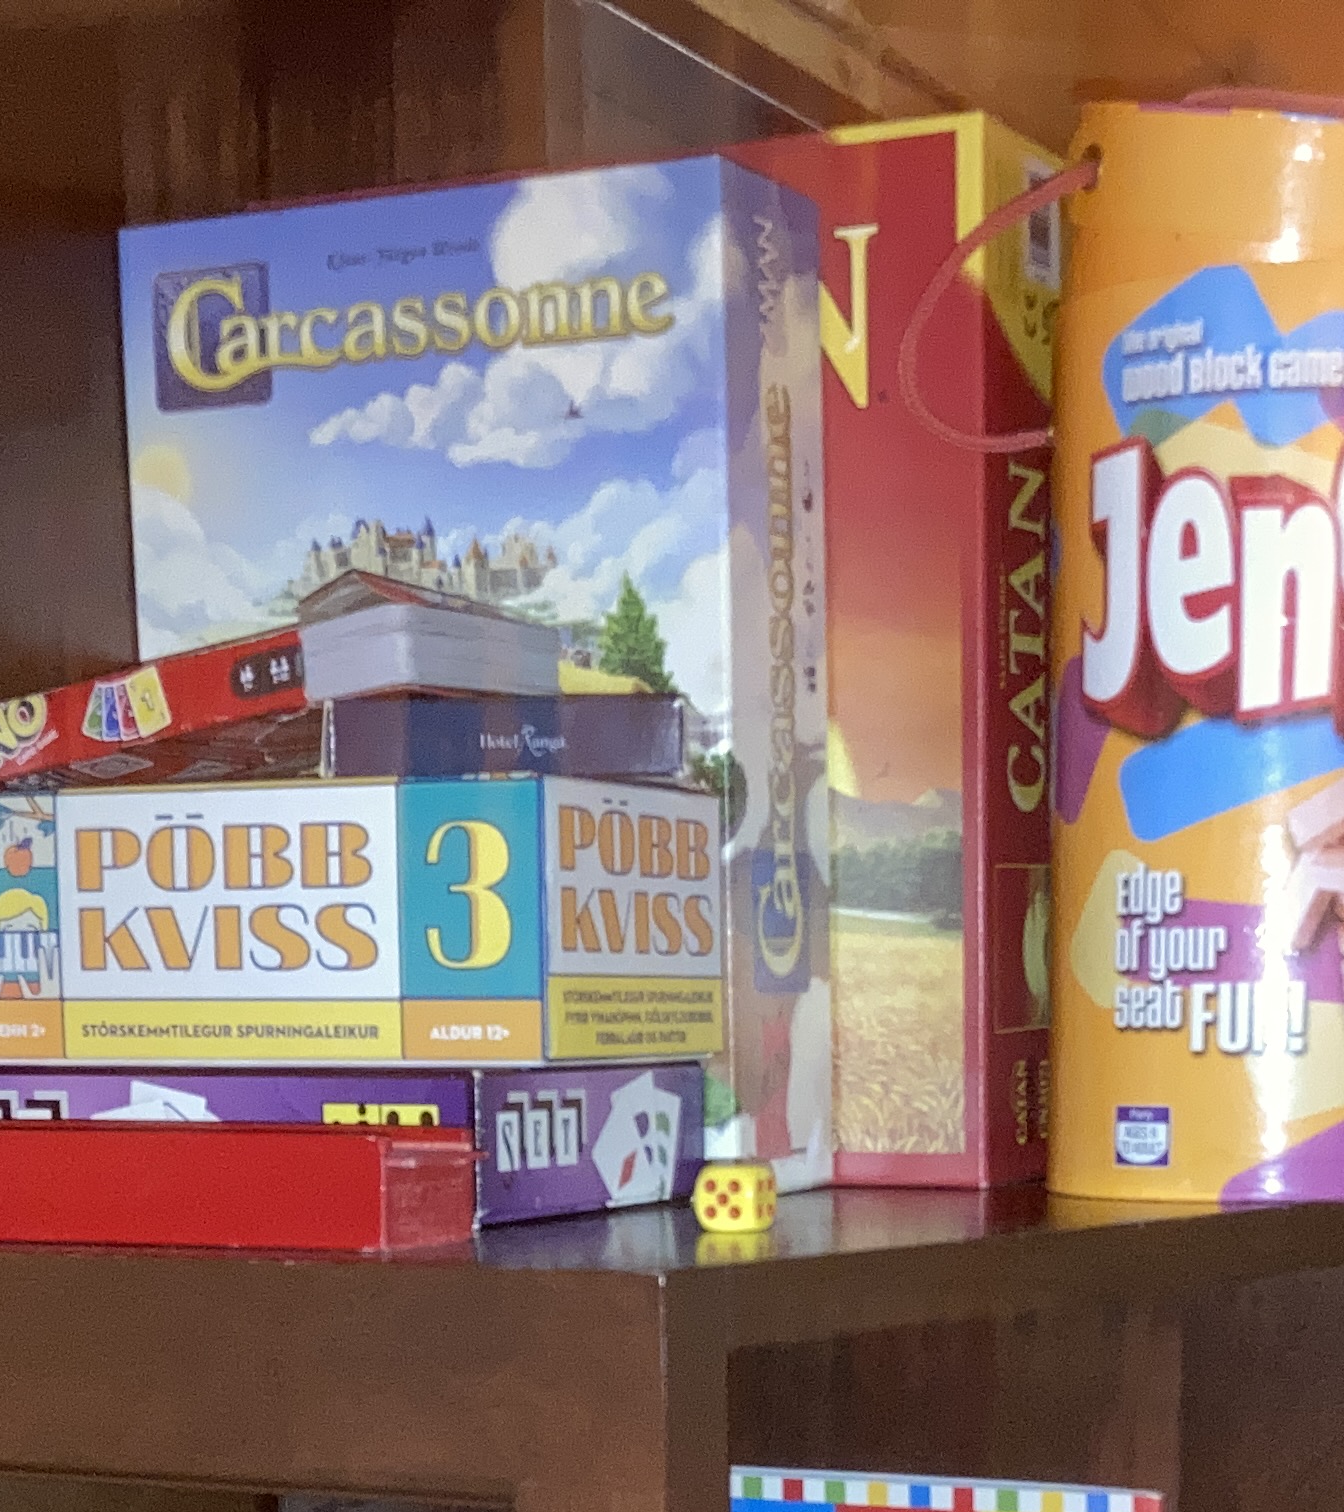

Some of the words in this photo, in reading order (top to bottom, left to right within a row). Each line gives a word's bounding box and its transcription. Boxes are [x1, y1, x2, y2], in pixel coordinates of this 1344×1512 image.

[166, 270, 678, 393] Carcassonne
[1006, 462, 1051, 812] CATAN
[74, 812, 374, 893] PÖBB
[556, 797, 711, 882] PÖBB
[423, 818, 511, 970] 3
[558, 885, 714, 959] KVISS
[1115, 863, 1184, 925] Edge
[79, 902, 379, 974] KVISS
[1115, 918, 1145, 972] of
[1148, 925, 1228, 981] your
[81, 1018, 233, 1039] STÓRSKEMMTILEGUR
[236, 1024, 380, 1040] SPURNINGALEIKUR
[429, 1024, 483, 1041] ALDUR
[1114, 978, 1183, 1029] seat
